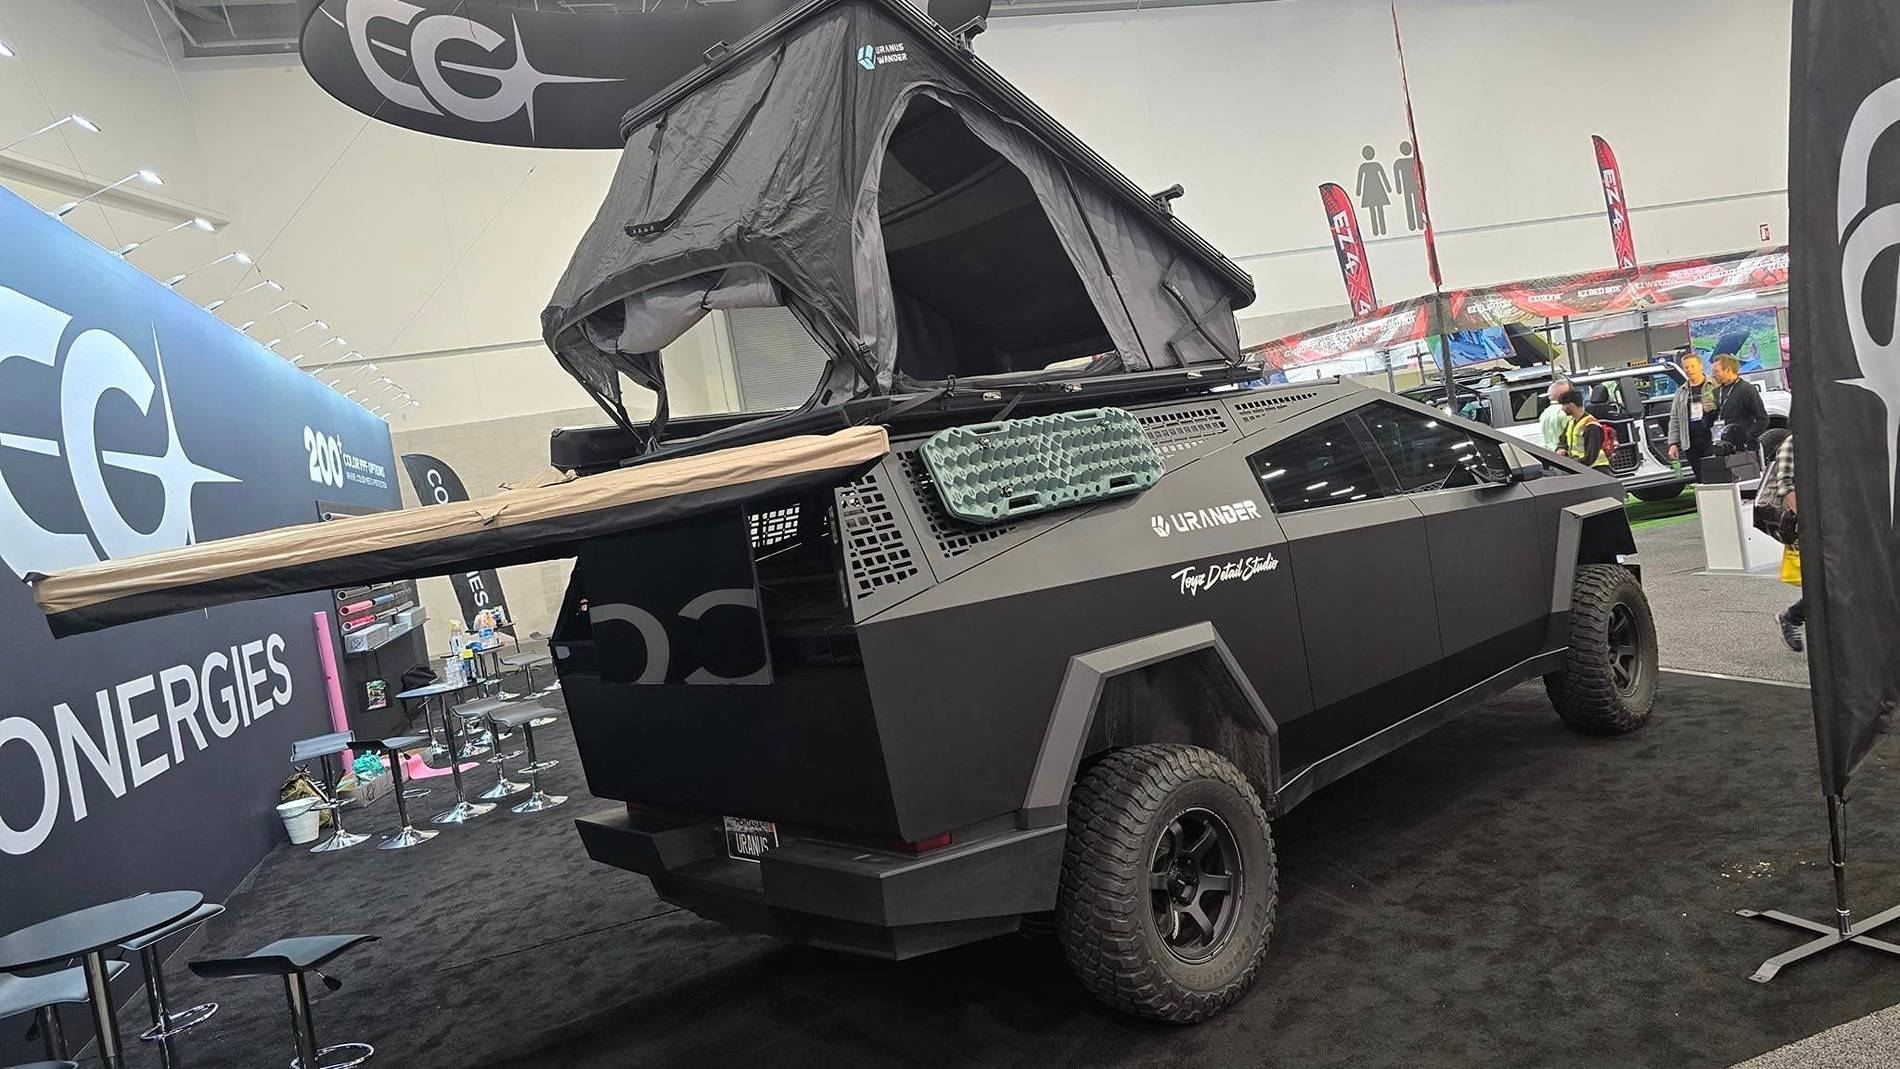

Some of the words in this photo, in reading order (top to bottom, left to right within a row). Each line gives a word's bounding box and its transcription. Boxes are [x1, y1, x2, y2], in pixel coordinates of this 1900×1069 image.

[875, 43, 904, 54] URANUS
[877, 53, 908, 65] WANDER
[1170, 499, 1262, 533] URANDER
[1171, 566, 1206, 596] Toyz
[1203, 558, 1243, 590] Detail
[1241, 552, 1279, 581] Studio
